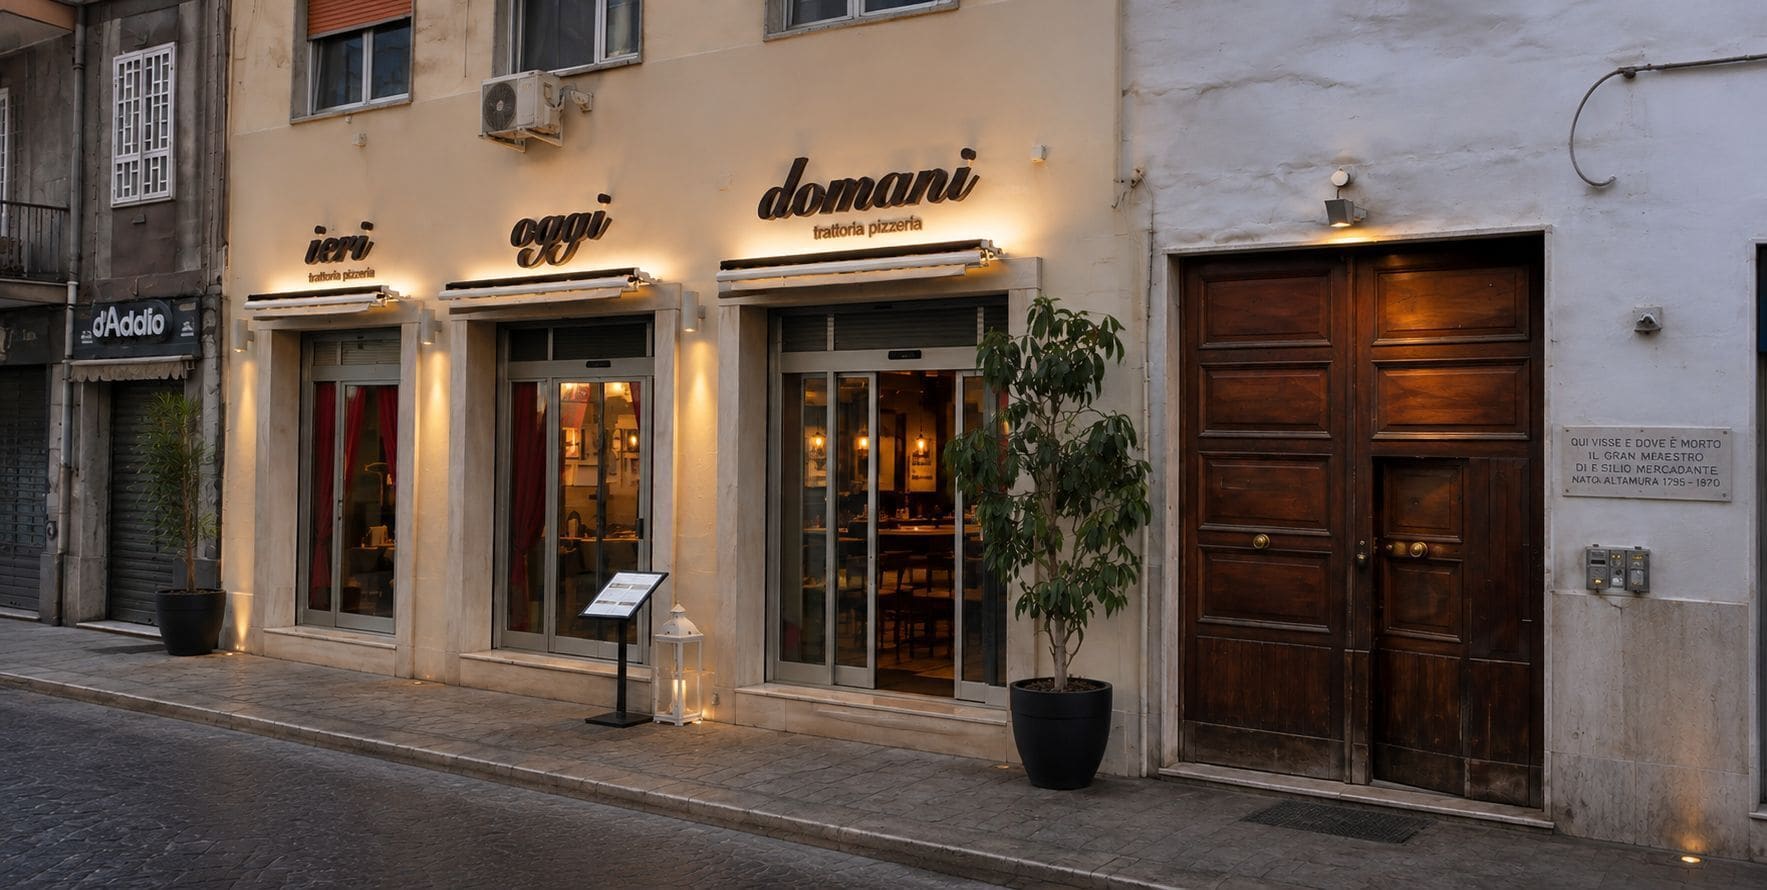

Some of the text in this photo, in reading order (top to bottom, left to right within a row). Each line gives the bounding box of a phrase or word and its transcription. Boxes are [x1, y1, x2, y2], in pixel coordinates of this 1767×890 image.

[757, 147, 980, 220] domani
[510, 193, 613, 269] oggi
[813, 215, 923, 240] trattoria pizzeria
[304, 221, 375, 265] ieri
[308, 267, 375, 283] trattoria pizzeria
[92, 306, 165, 338] d'Addio
[1570, 437, 1589, 447] QUI
[1591, 438, 1622, 448] VISSE
[1625, 438, 1632, 448] E
[1635, 438, 1666, 449] DOVE
[1680, 439, 1722, 449] MORTO
[1588, 451, 1600, 460] IL
[1604, 451, 1636, 461] GRAN
[1575, 463, 1587, 472] DI
[1636, 464, 1719, 476] MERCADANTE
[1603, 476, 1660, 487] ALTAMURA
